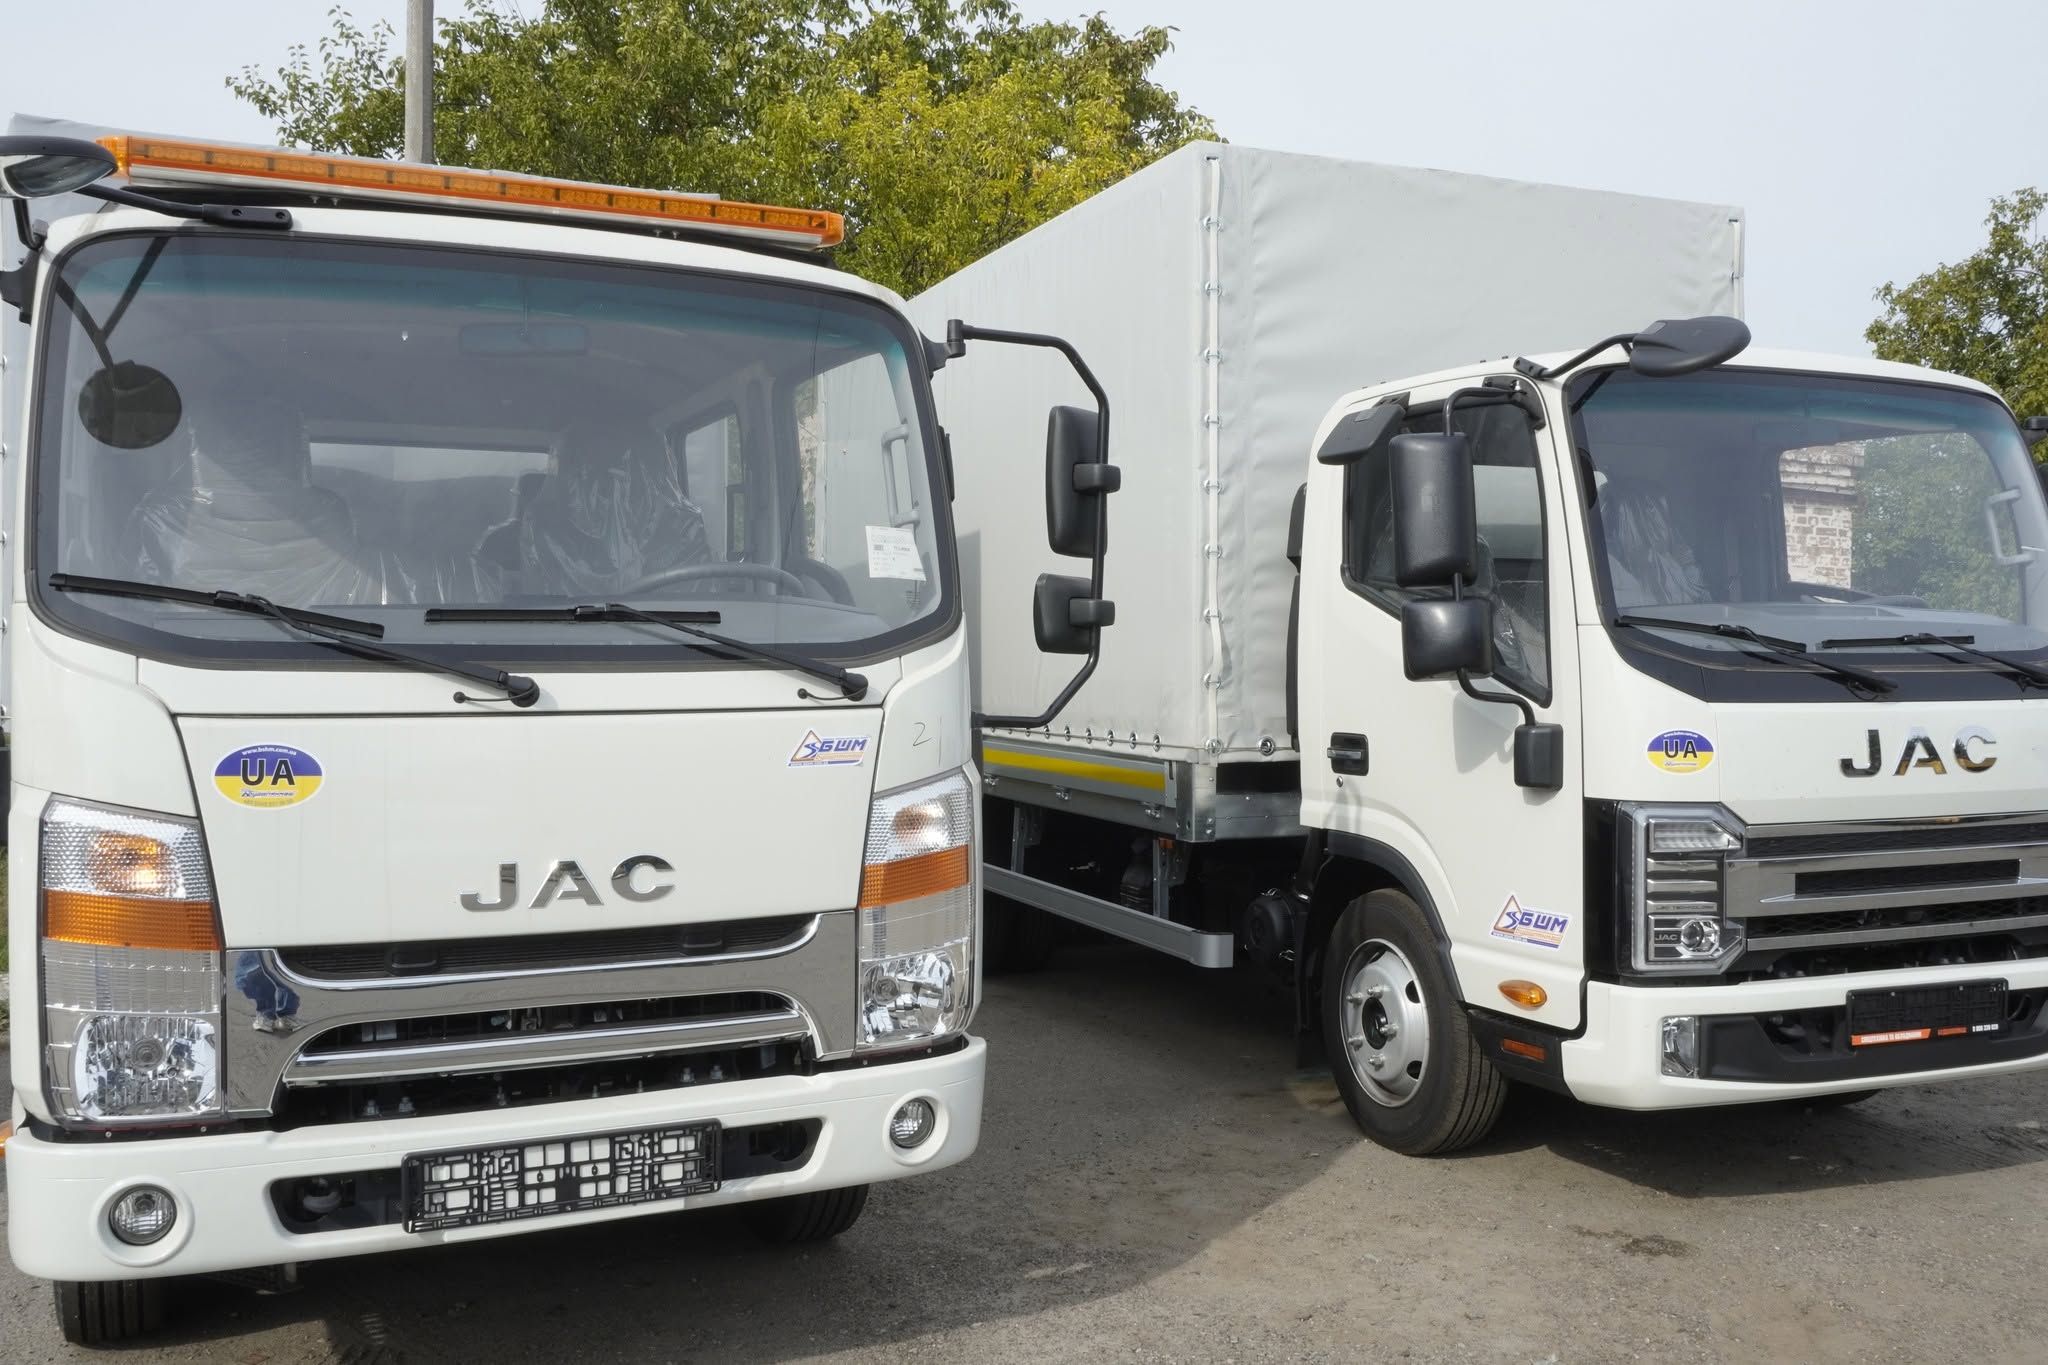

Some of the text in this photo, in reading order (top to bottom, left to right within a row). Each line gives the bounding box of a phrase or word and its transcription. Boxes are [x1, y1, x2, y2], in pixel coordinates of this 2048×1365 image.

[1663, 739, 1698, 758] UA
[1840, 725, 1998, 778] JAC
[241, 758, 296, 786] UA
[460, 855, 676, 912] JAC
[1655, 933, 1679, 941] JAC
